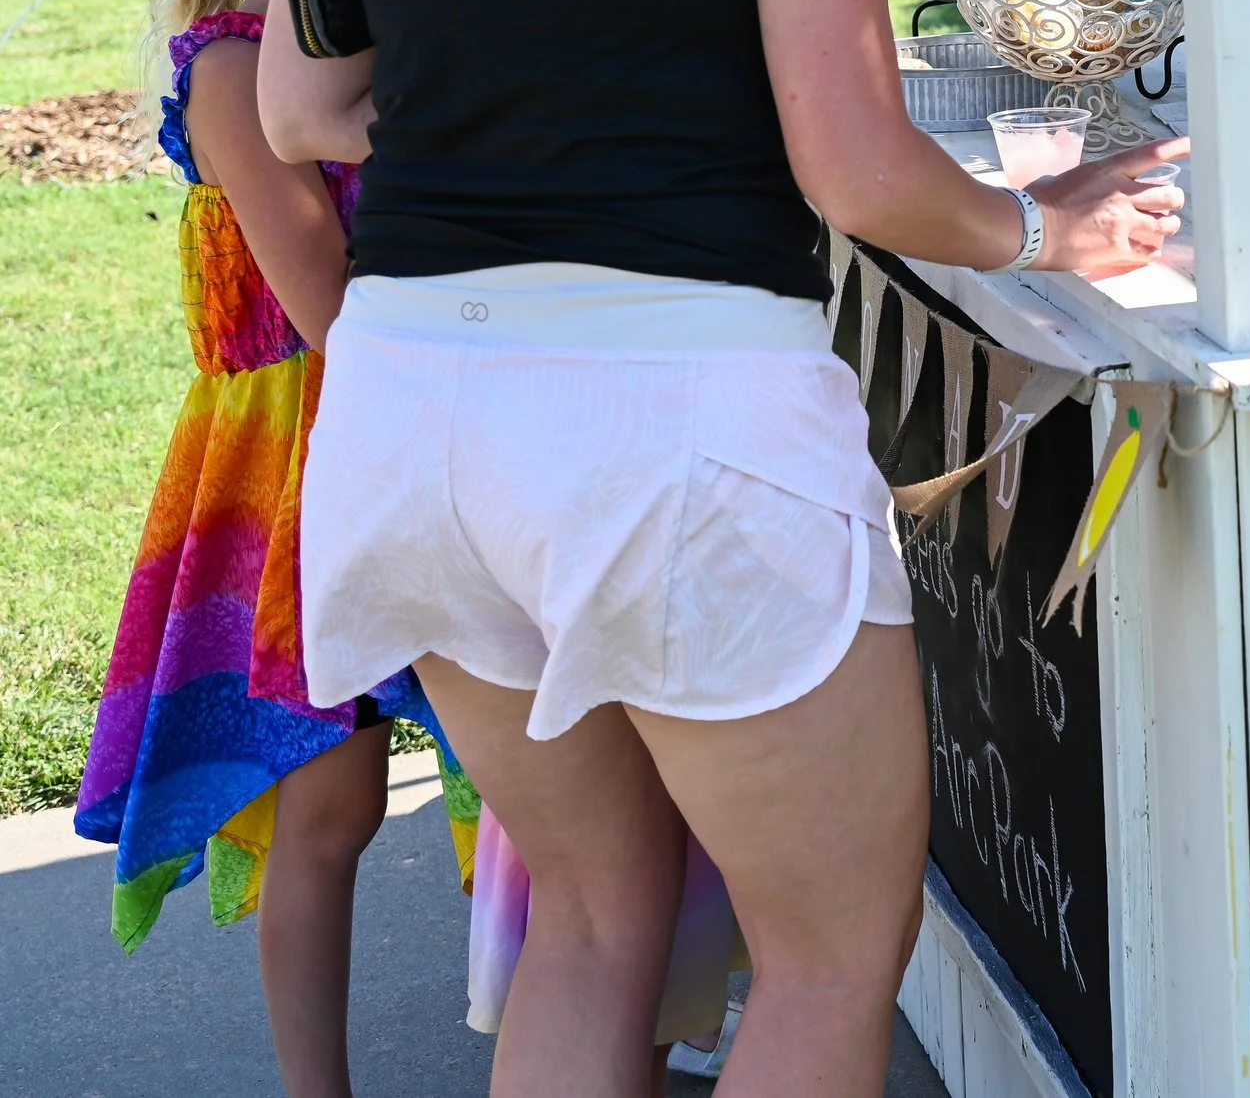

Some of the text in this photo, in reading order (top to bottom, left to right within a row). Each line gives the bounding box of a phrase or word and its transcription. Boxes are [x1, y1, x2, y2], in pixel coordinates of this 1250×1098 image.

[972, 573, 1004, 718] go
[1018, 570, 1067, 744] to
[983, 740, 1087, 994] Park
